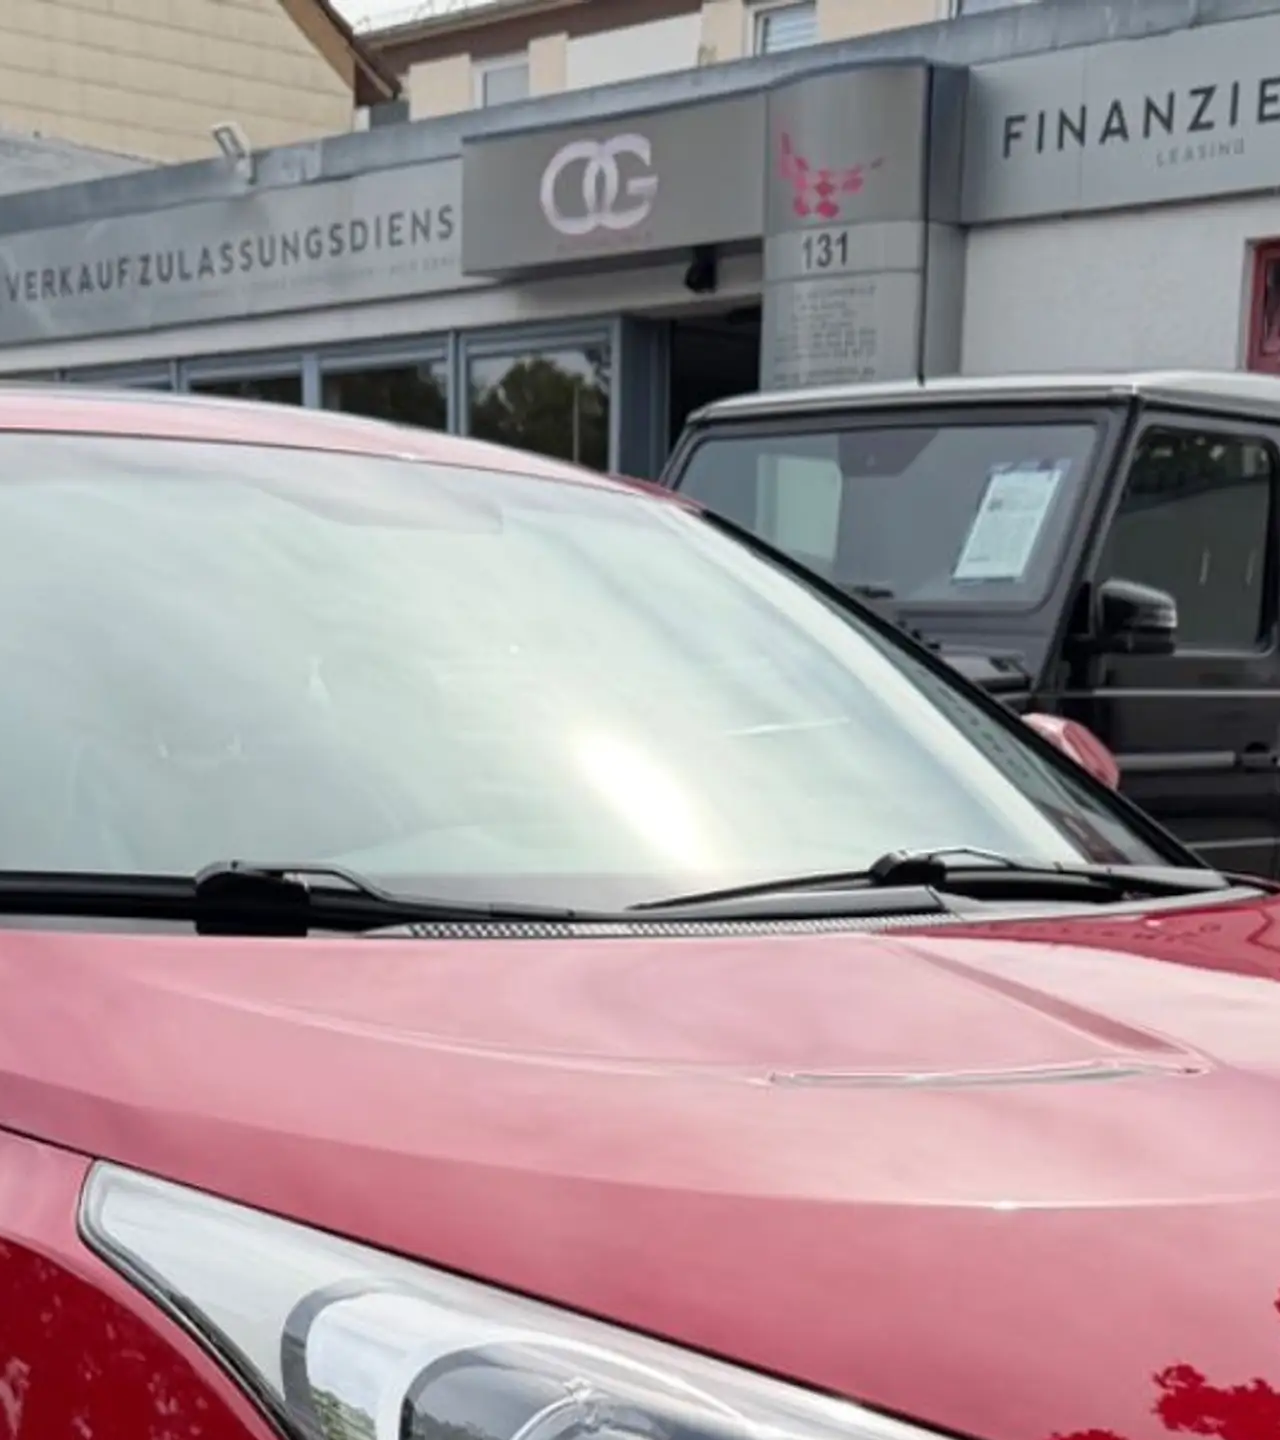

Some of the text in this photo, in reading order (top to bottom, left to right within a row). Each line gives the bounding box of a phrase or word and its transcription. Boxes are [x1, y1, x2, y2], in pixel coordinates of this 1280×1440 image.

[1155, 137, 1245, 168] LEASING
[540, 133, 659, 236] OG
[803, 231, 849, 270] 131
[5, 256, 130, 302] VERKAUF
